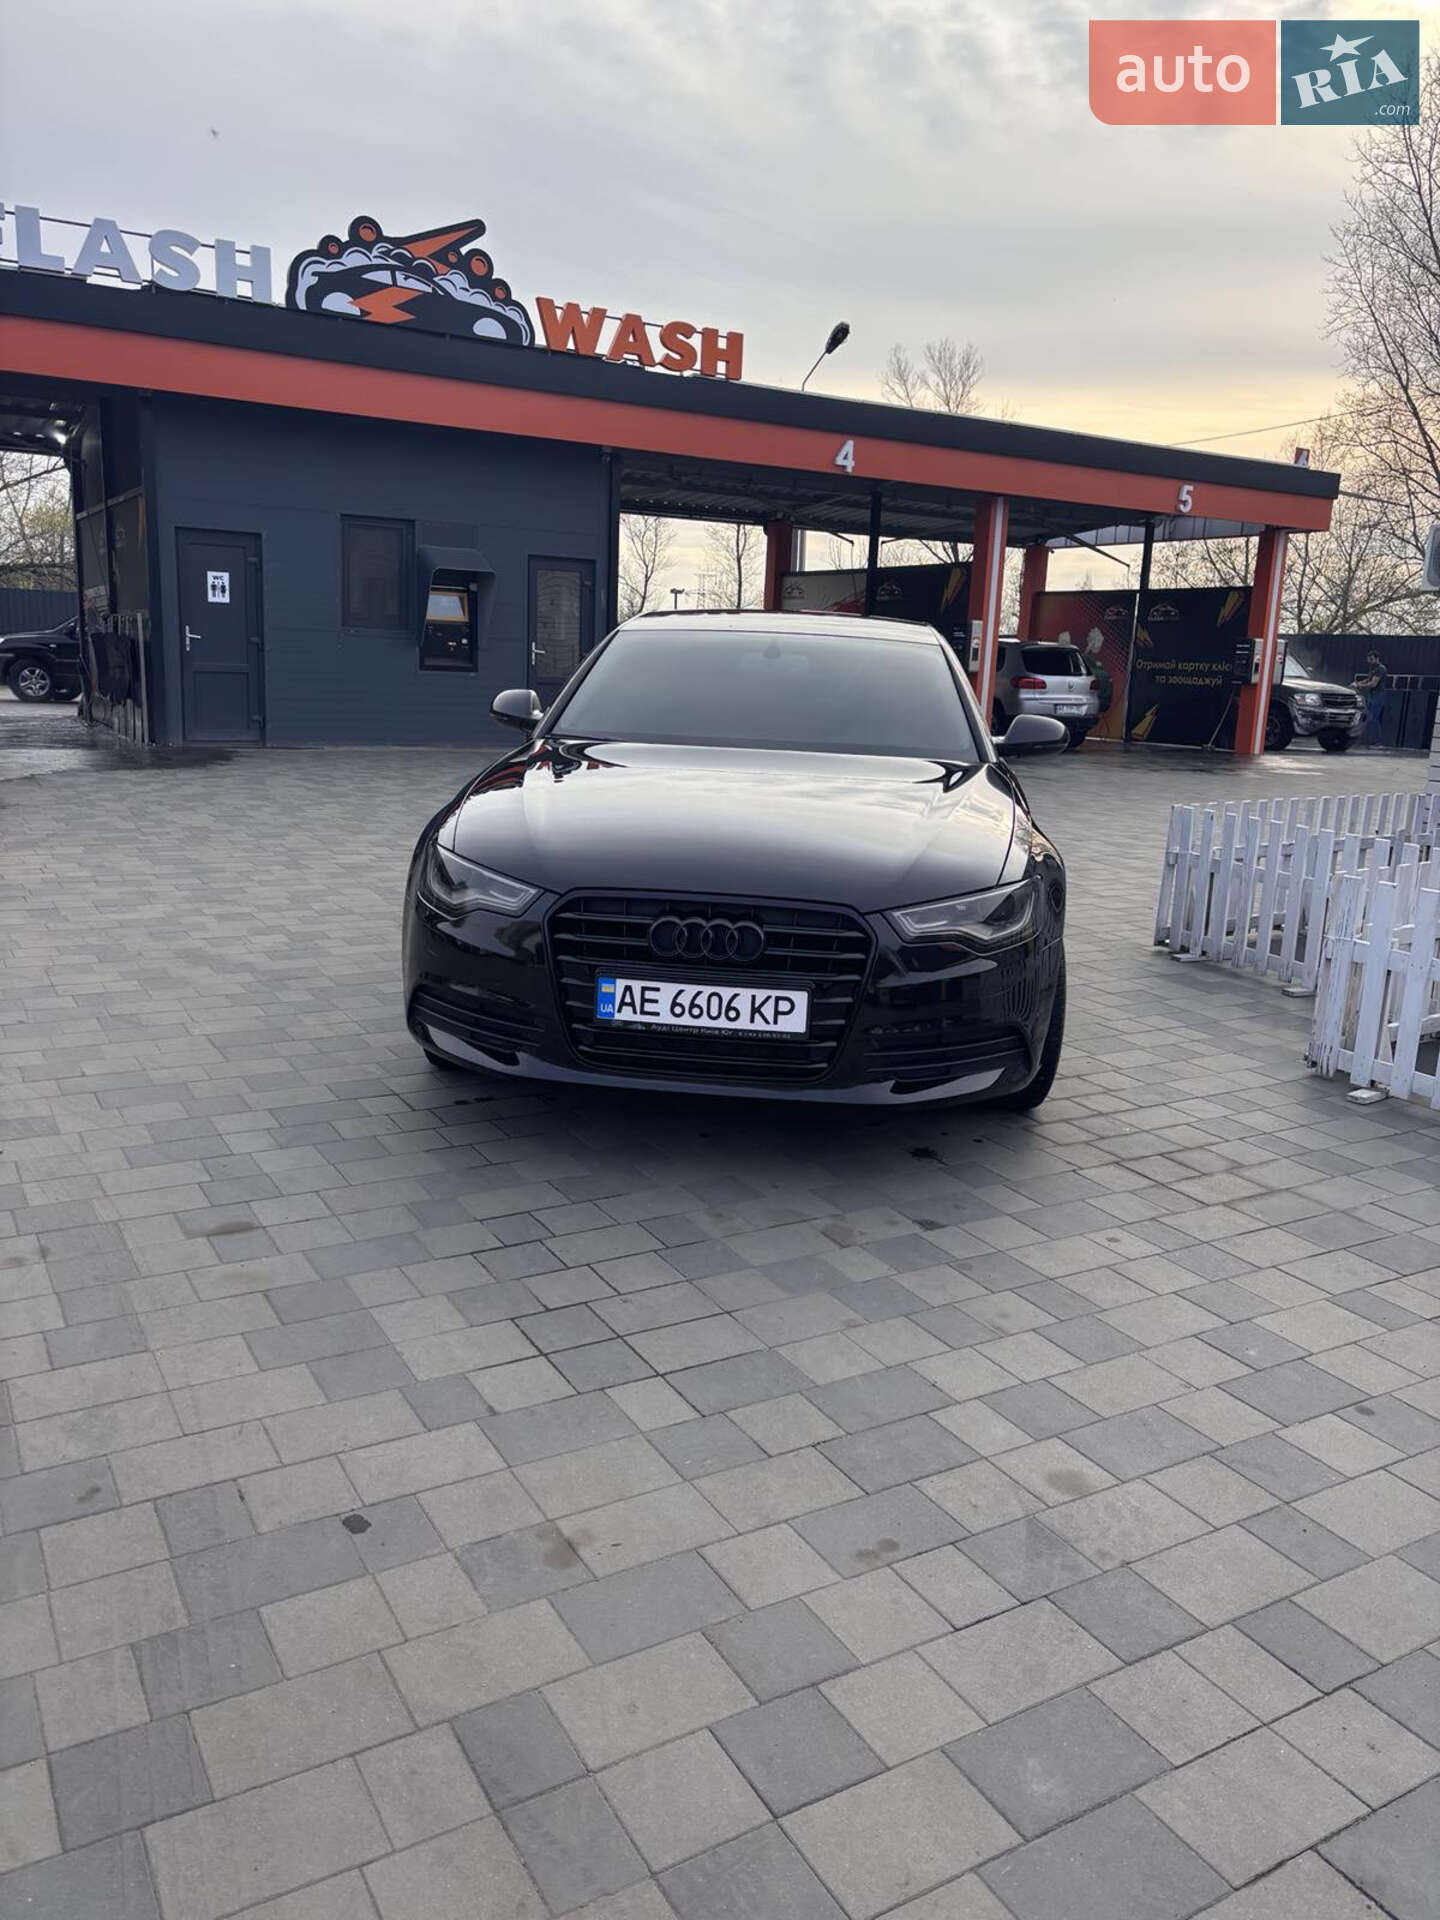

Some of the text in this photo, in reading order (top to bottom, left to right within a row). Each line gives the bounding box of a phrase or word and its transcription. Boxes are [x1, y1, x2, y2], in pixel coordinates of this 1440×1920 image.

[0, 203, 744, 381] LASH WASH
[834, 439, 856, 473] 4
[1176, 484, 1195, 513] 5
[1136, 658, 1176, 672] Отримай
[1154, 675, 1167, 685] та
[600, 984, 796, 1026] UA AE 6606 KP
